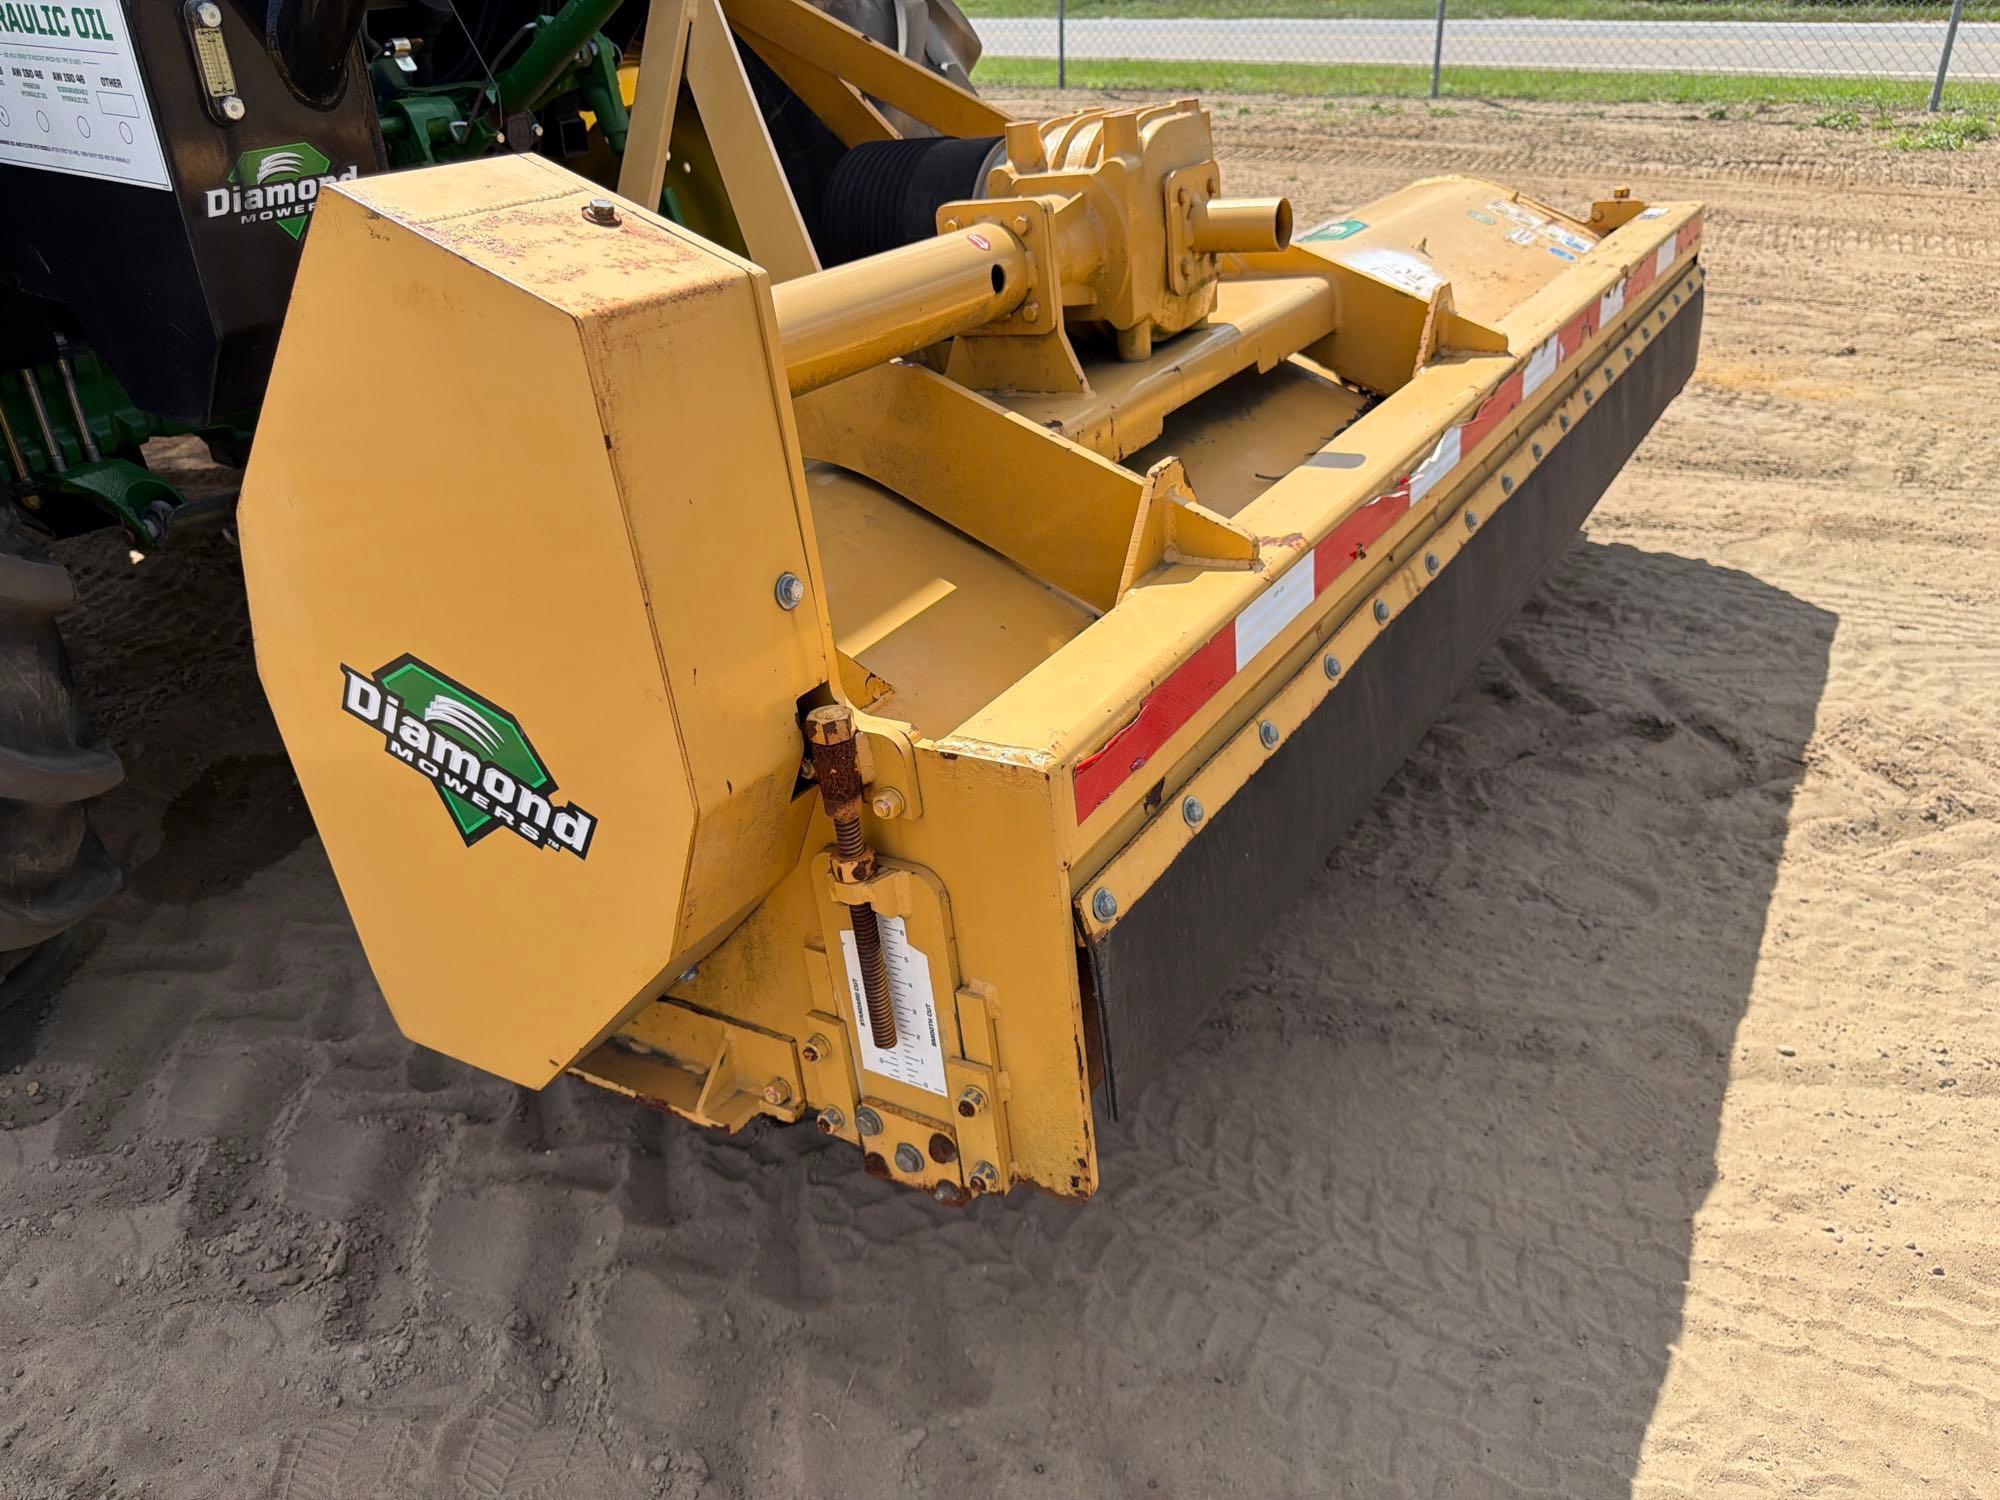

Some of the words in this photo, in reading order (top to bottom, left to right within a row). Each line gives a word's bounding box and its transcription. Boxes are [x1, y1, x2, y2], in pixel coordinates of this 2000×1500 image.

[71, 7, 114, 41] OIL
[22, 68, 34, 78] ISO
[34, 70, 44, 79] 46
[63, 73, 75, 83] ISO
[76, 74, 85, 84] 46
[100, 77, 122, 88] OTHER
[241, 202, 316, 224] MOWE
[347, 671, 592, 852] Diamond
[391, 741, 541, 842] MOWERS
[855, 992, 865, 1027] STANDARD
[928, 1018, 937, 1047] SMOOTH
